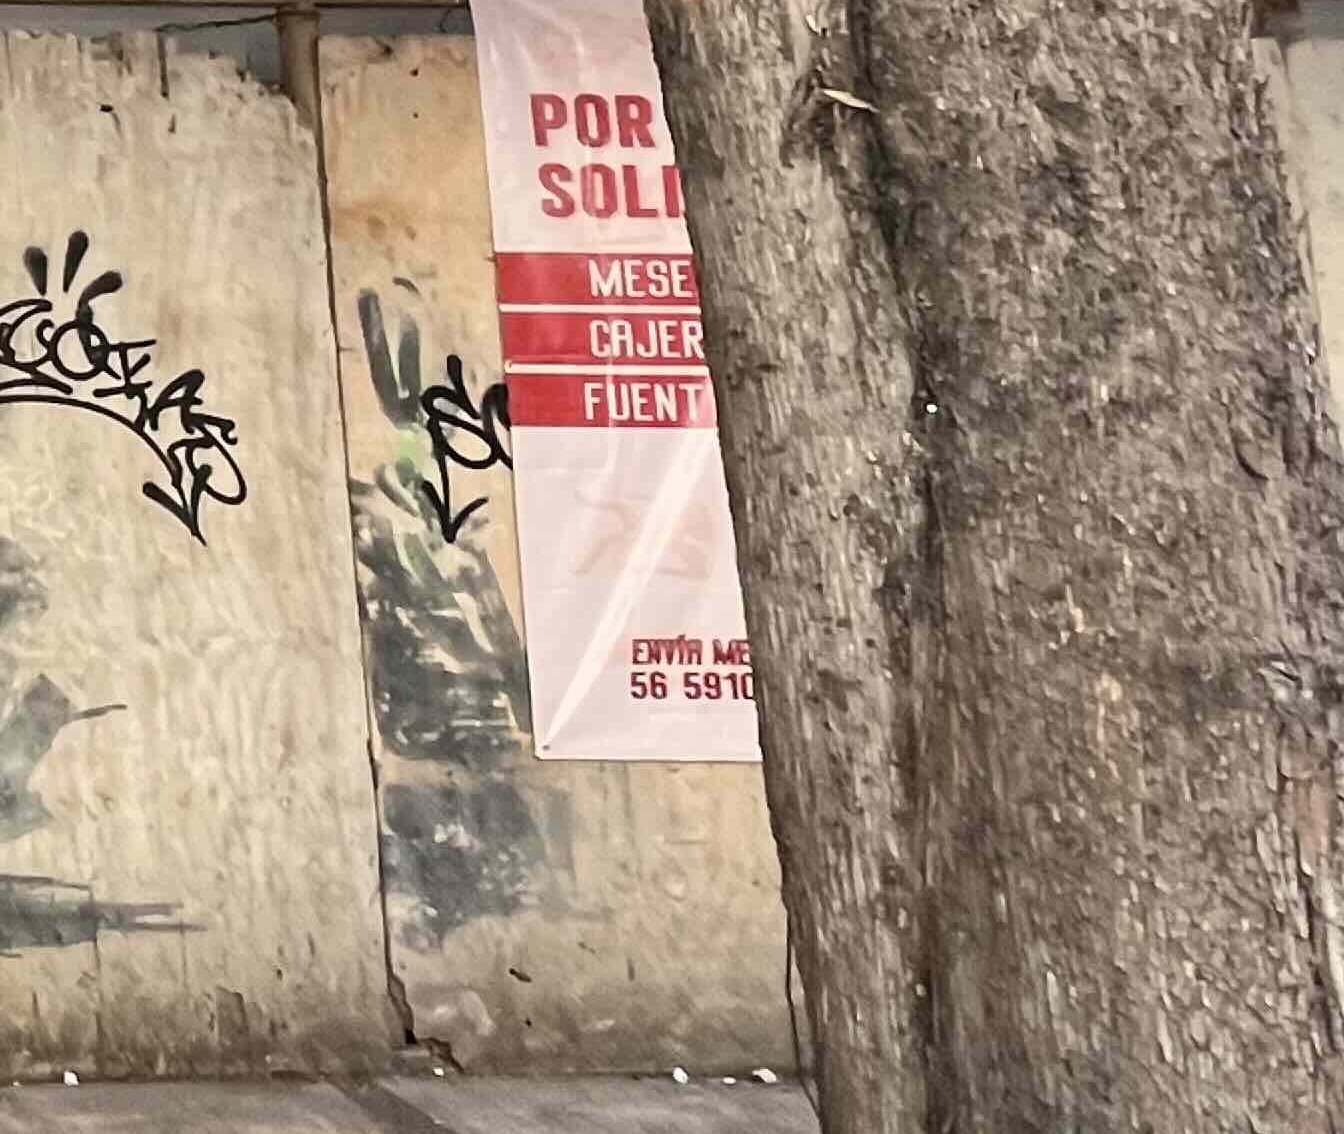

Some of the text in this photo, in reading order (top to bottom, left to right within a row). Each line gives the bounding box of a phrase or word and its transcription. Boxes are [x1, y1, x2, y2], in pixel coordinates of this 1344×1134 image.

[530, 94, 656, 147] POR
[588, 258, 694, 298] MESE
[589, 319, 705, 360] CAJER
[583, 382, 705, 422] FUENT
[630, 671, 667, 700] 56
